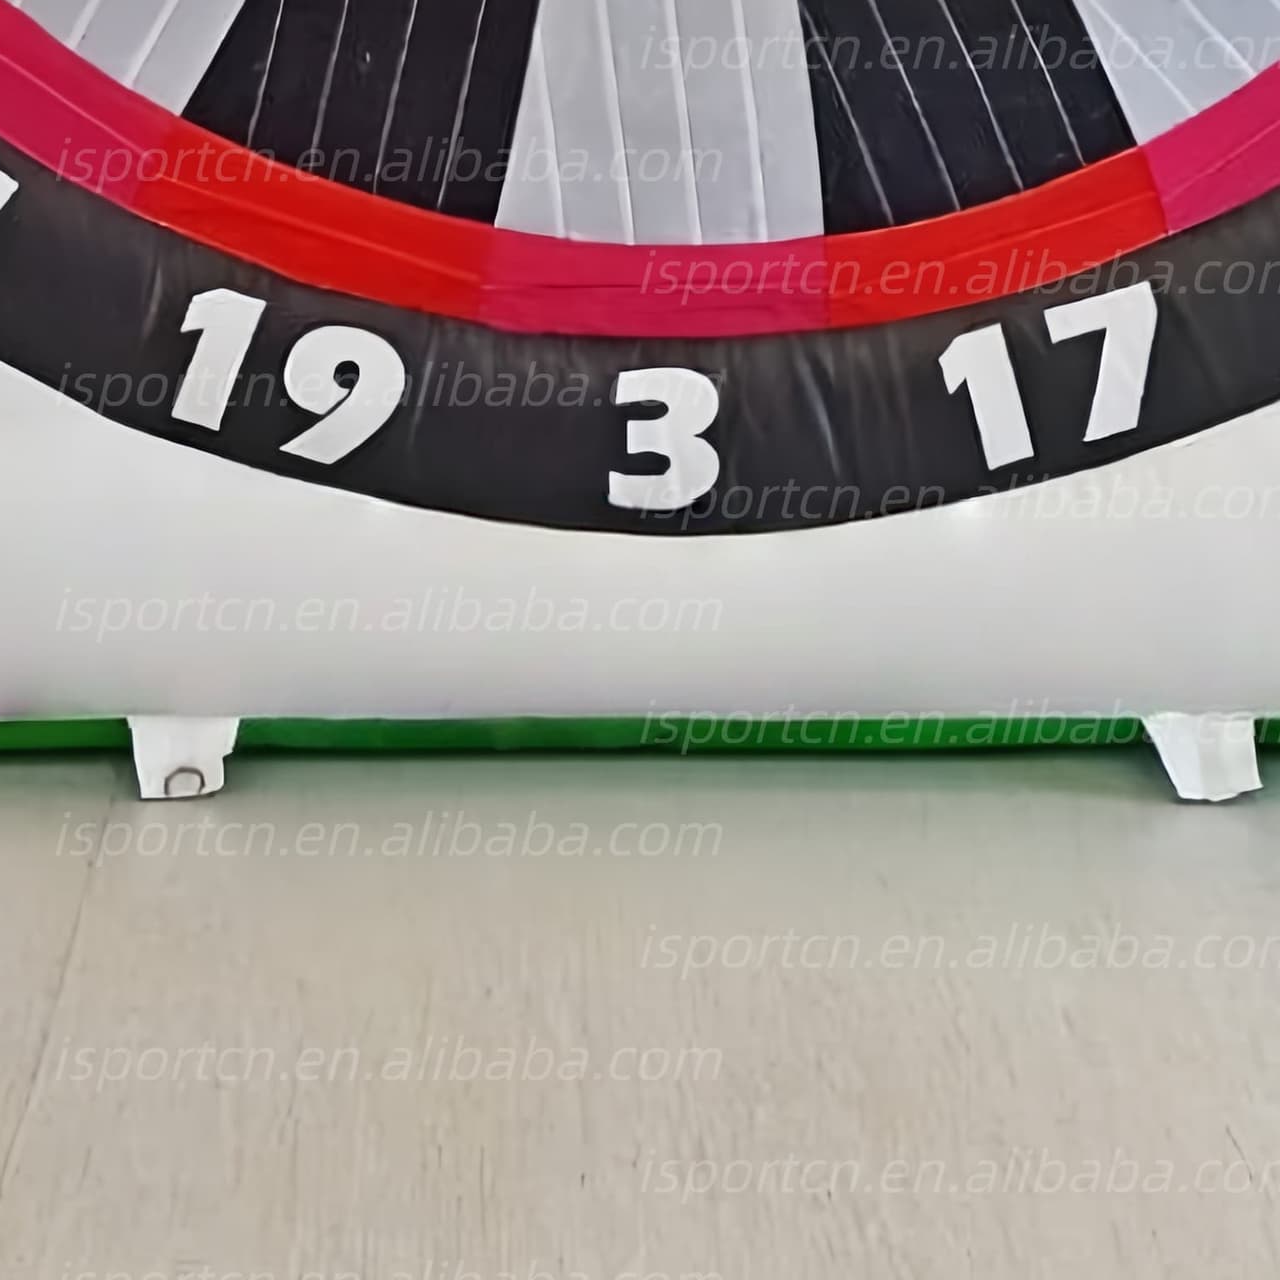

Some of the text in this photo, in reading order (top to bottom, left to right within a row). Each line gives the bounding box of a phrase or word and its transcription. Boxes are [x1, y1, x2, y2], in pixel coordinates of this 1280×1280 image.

[172, 288, 405, 464] 19
[609, 367, 720, 509] 3
[940, 282, 1157, 470] 17
